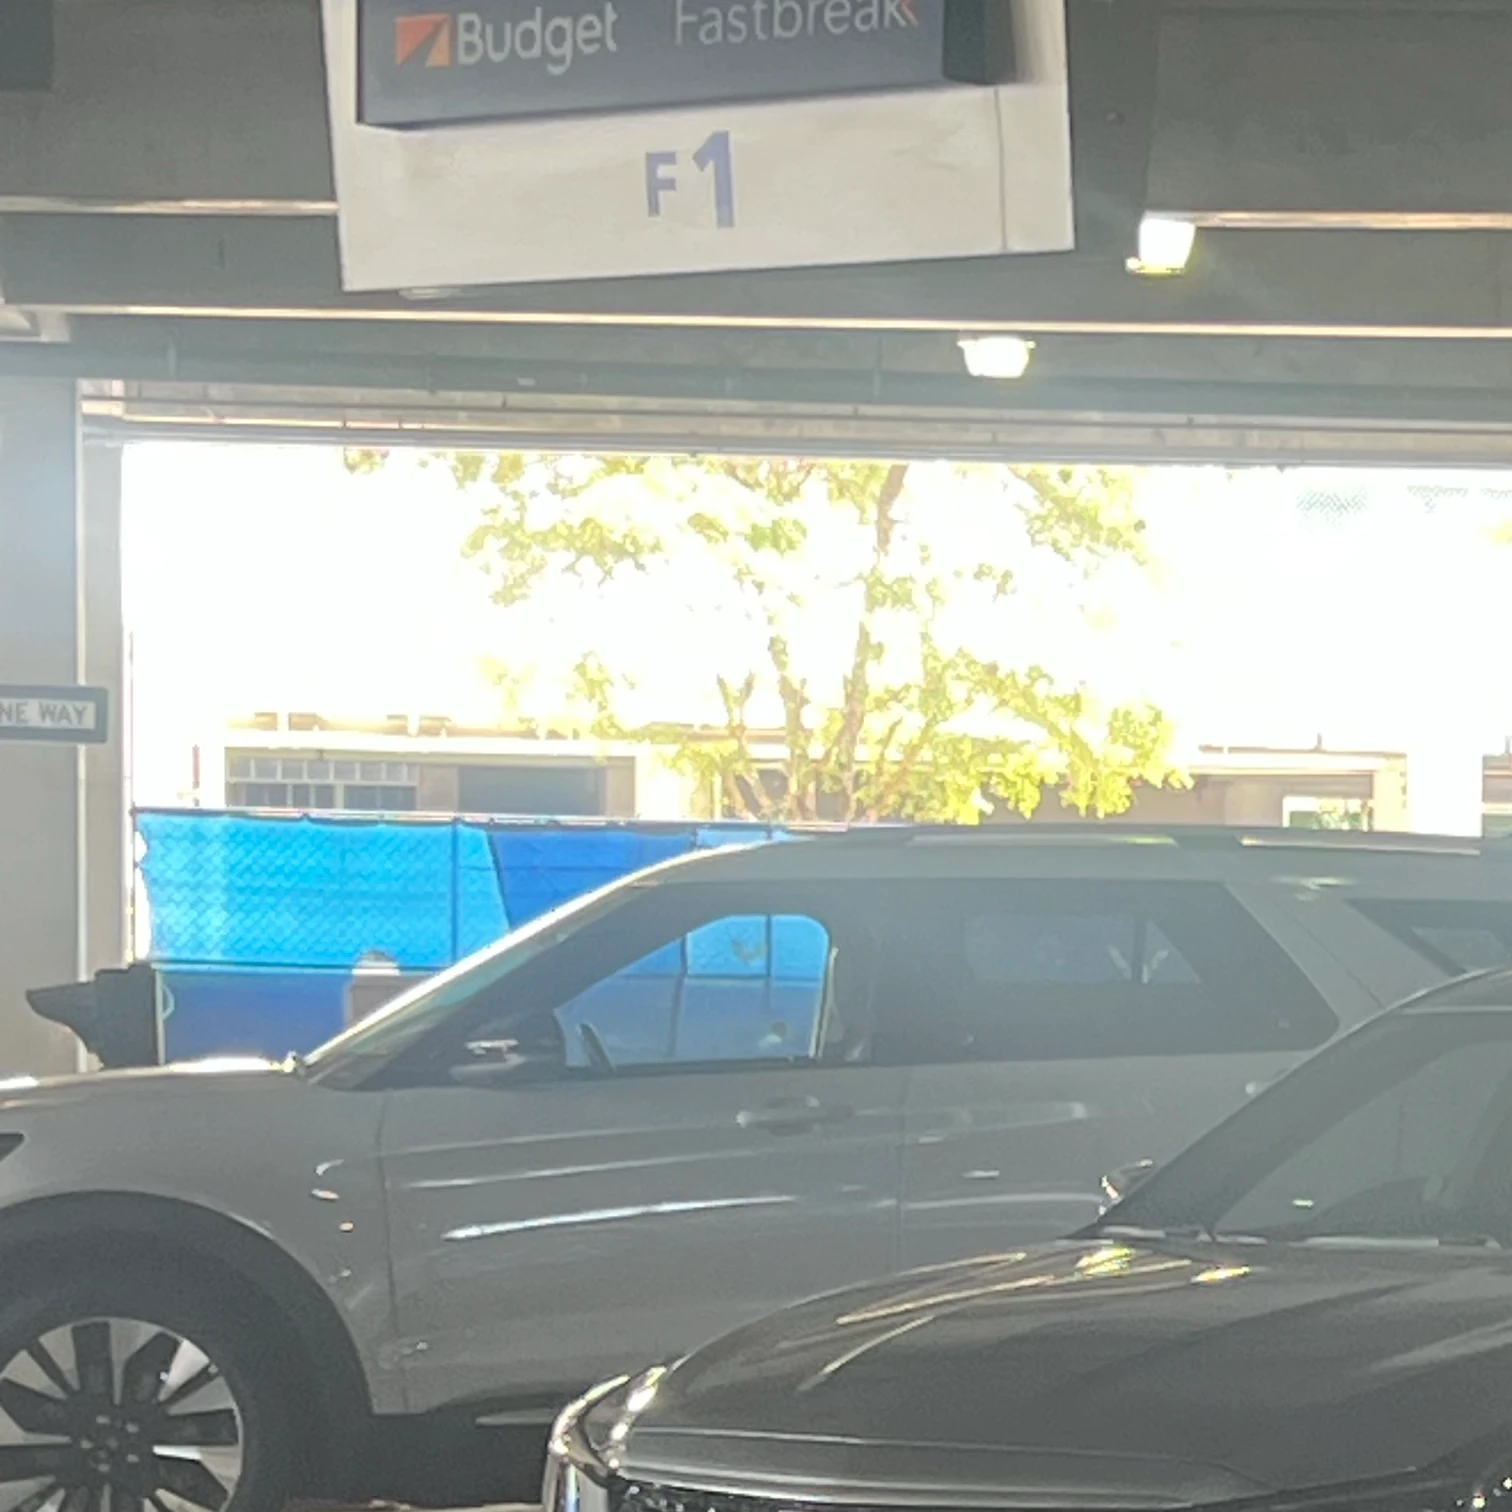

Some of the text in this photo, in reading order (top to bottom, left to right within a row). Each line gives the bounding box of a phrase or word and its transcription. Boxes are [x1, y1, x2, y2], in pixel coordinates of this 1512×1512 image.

[456, 0, 907, 76] Budget Fastbreak
[38, 701, 88, 727] WAY
